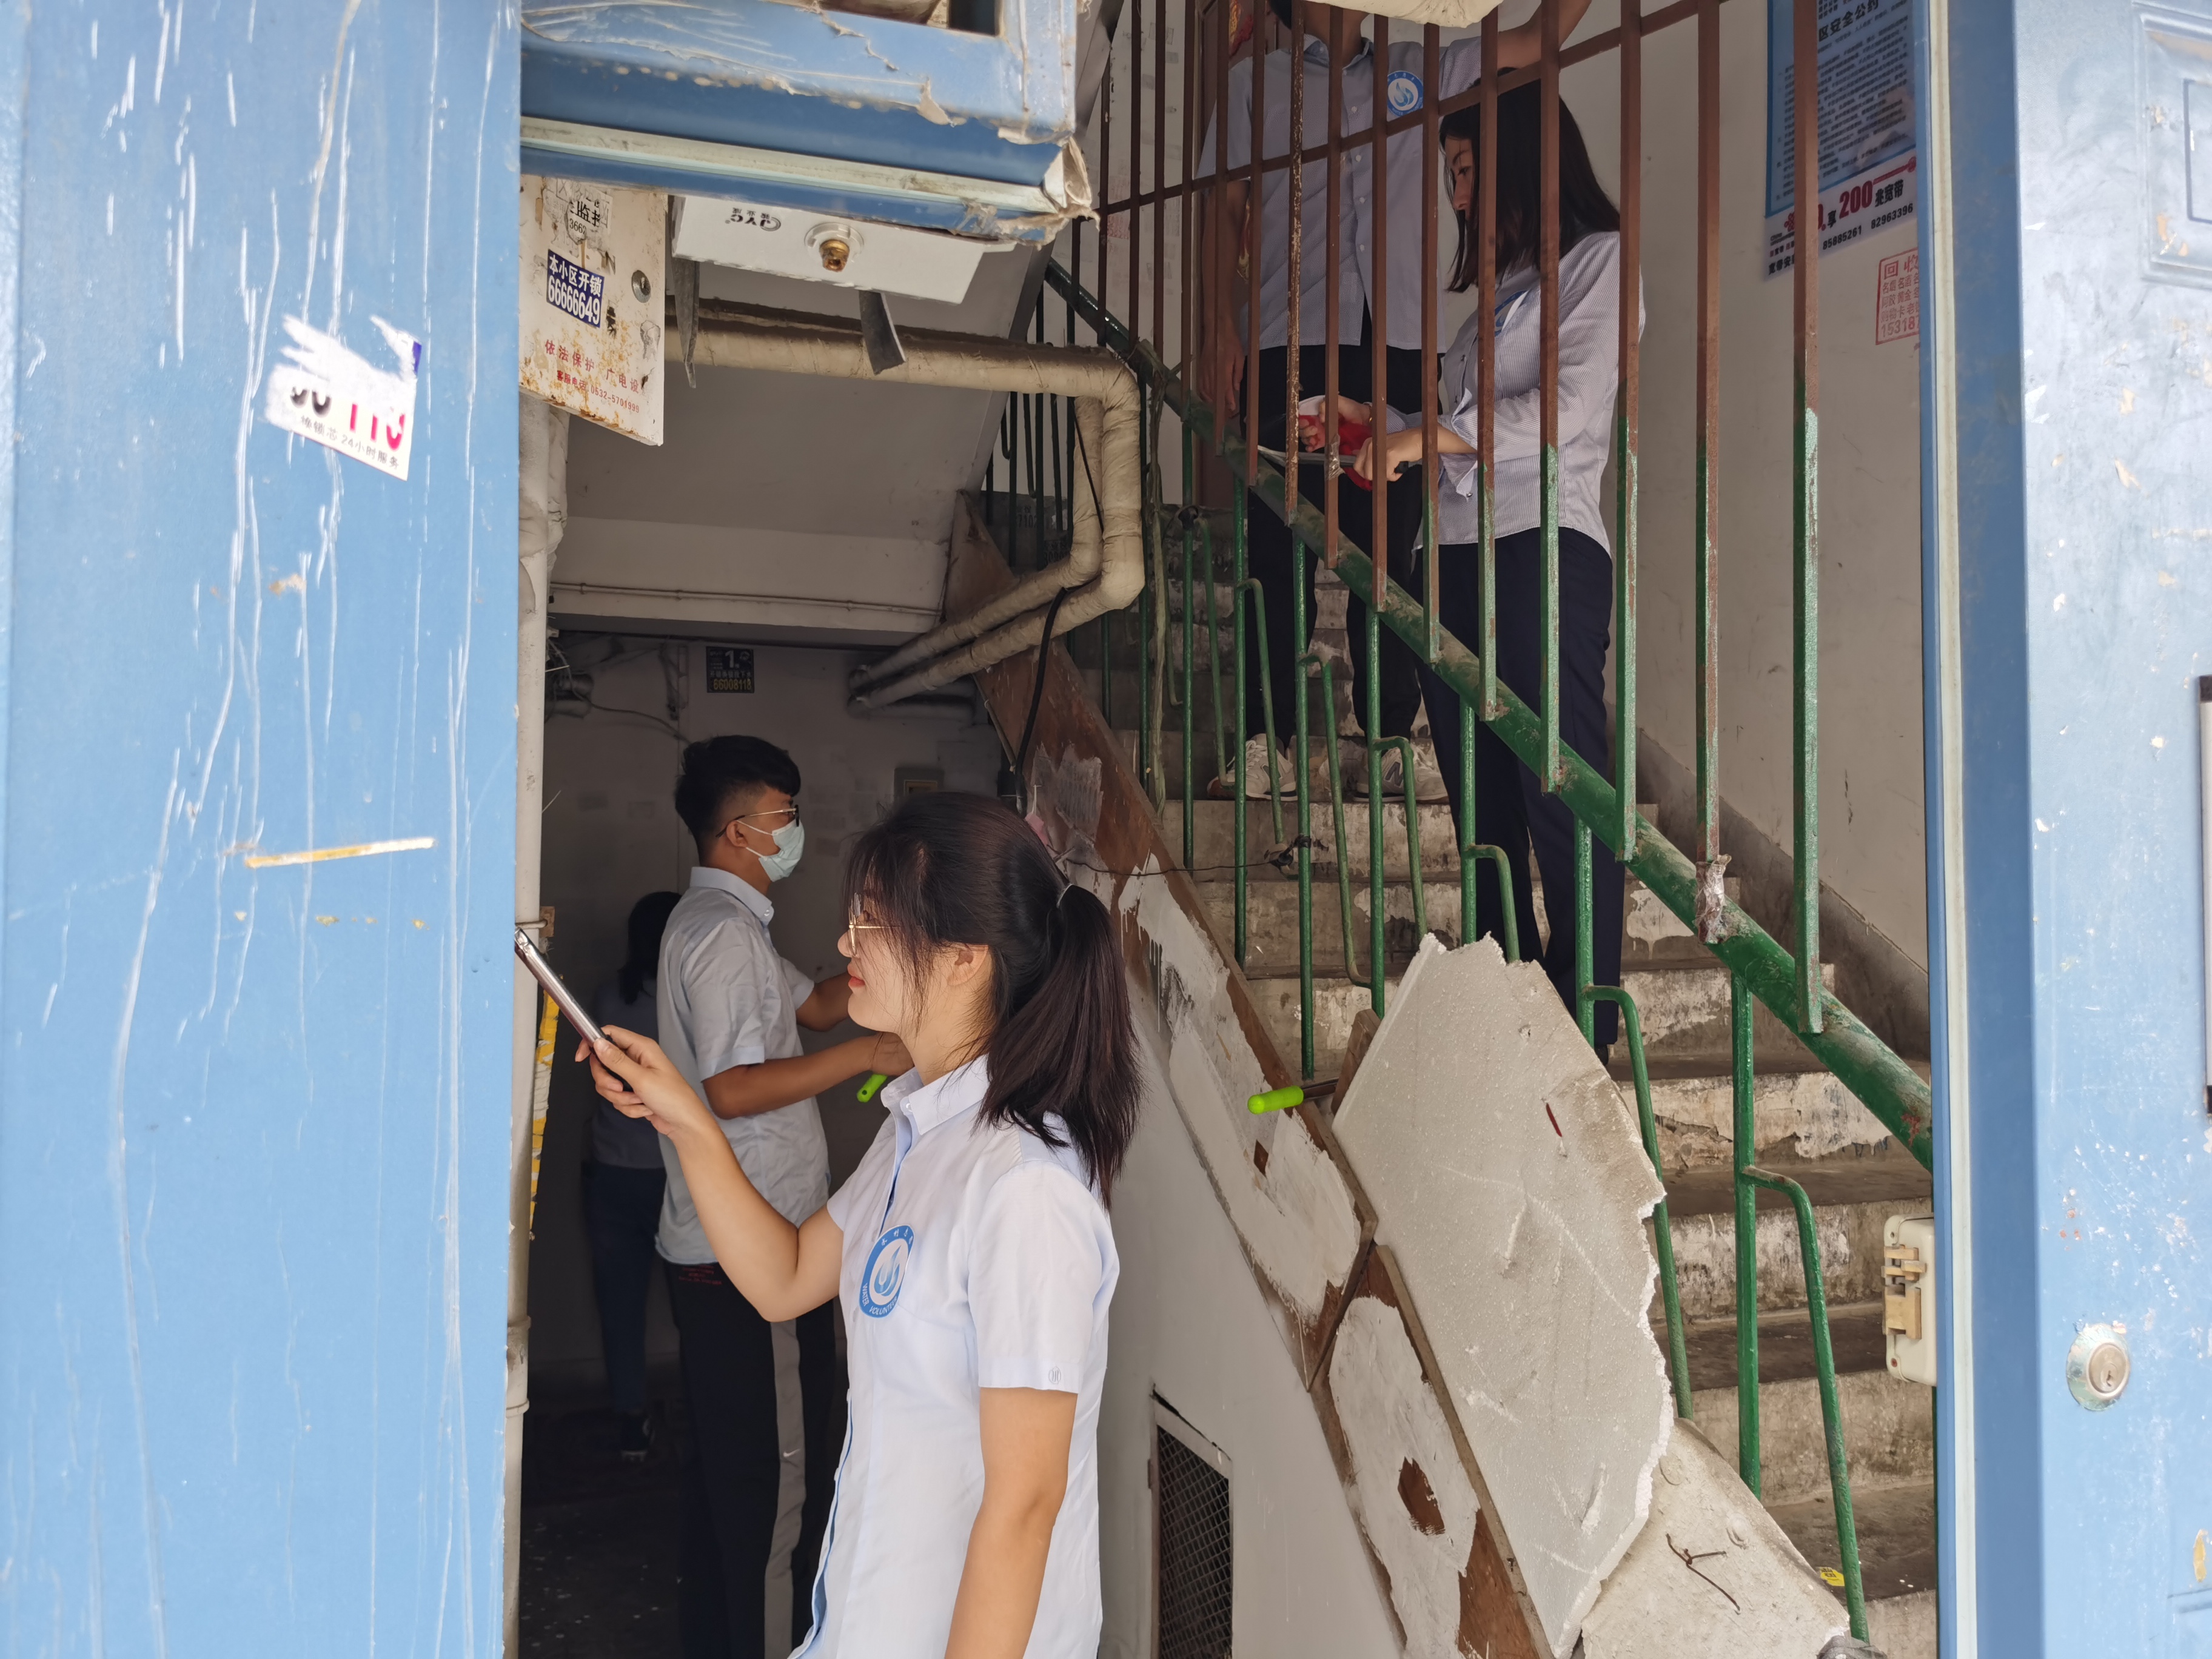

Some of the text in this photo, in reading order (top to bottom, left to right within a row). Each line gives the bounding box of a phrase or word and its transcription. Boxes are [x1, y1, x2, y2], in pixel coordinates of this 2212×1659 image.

[1823, 225, 1862, 250] 85885261
[1871, 203, 1914, 229] 82963396
[549, 254, 602, 298] 本小区开锁
[548, 275, 601, 325] 66666649
[545, 339, 595, 372] 依法保护
[869, 1295, 898, 1315] VOLUNTEER
